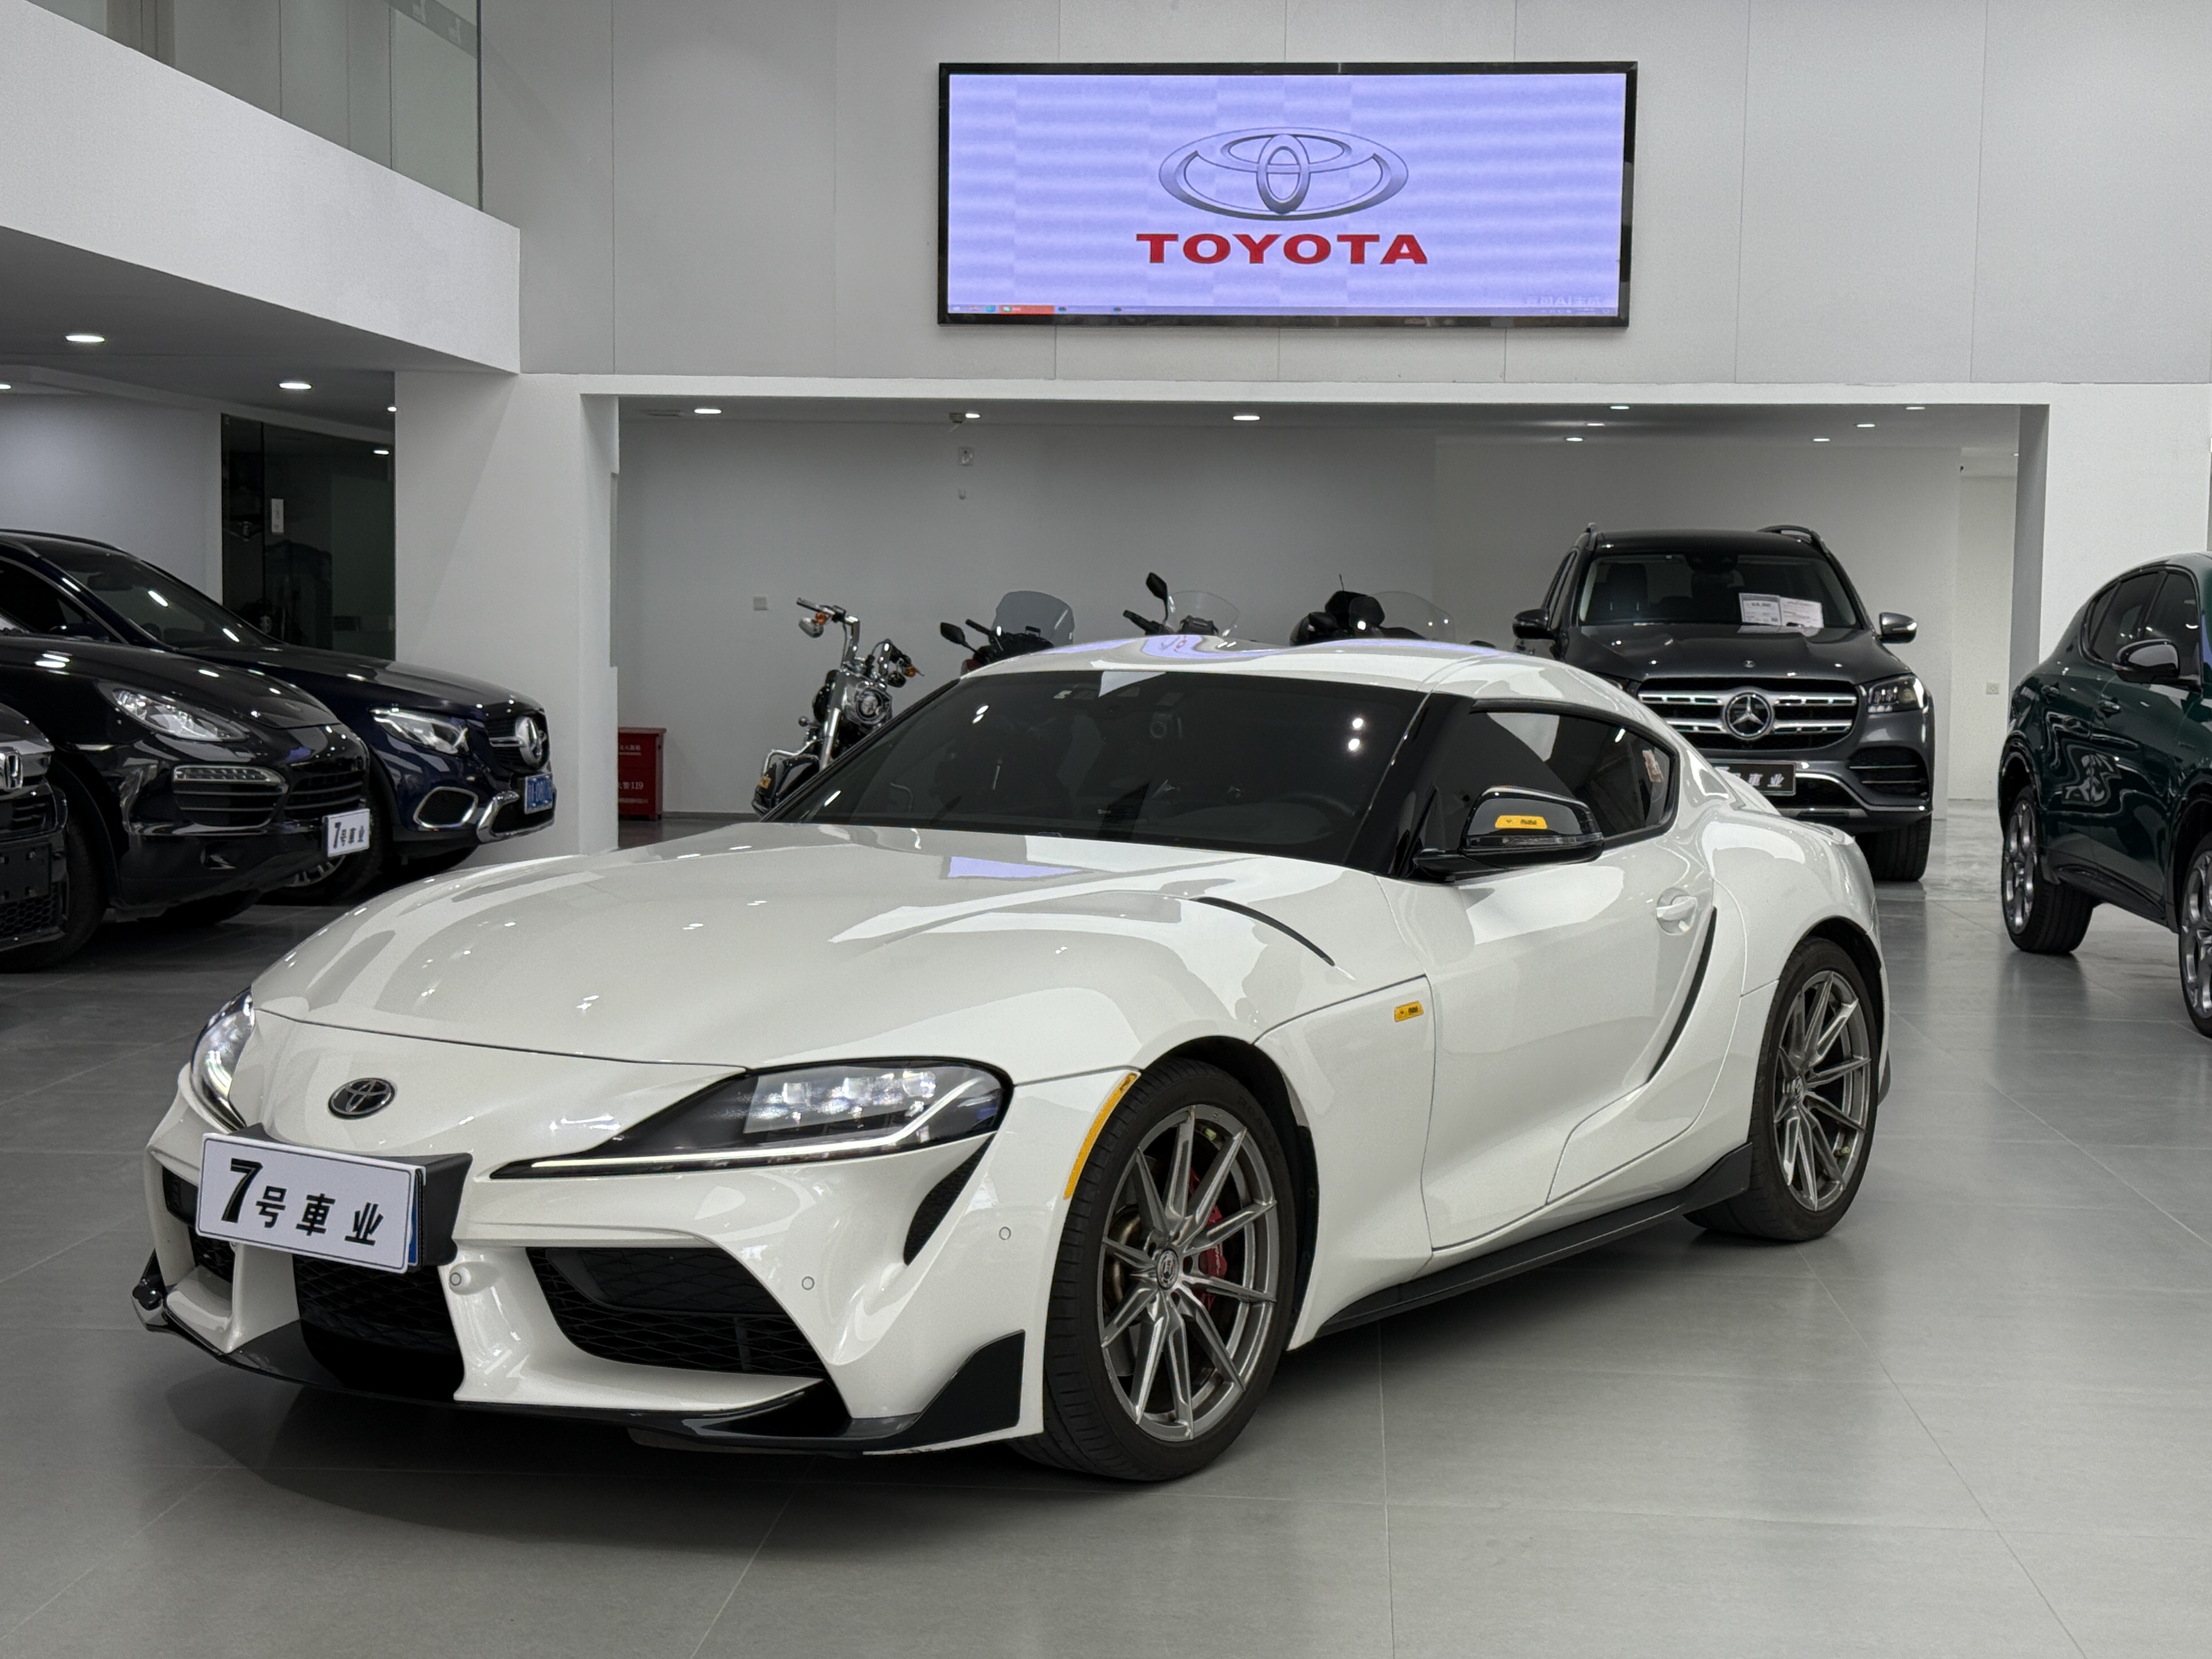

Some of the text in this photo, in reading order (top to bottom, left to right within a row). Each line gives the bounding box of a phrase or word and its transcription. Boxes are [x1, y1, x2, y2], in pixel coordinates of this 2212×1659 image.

[1136, 234, 1427, 264] TOYOTA
[221, 1158, 383, 1246] 7号車业
